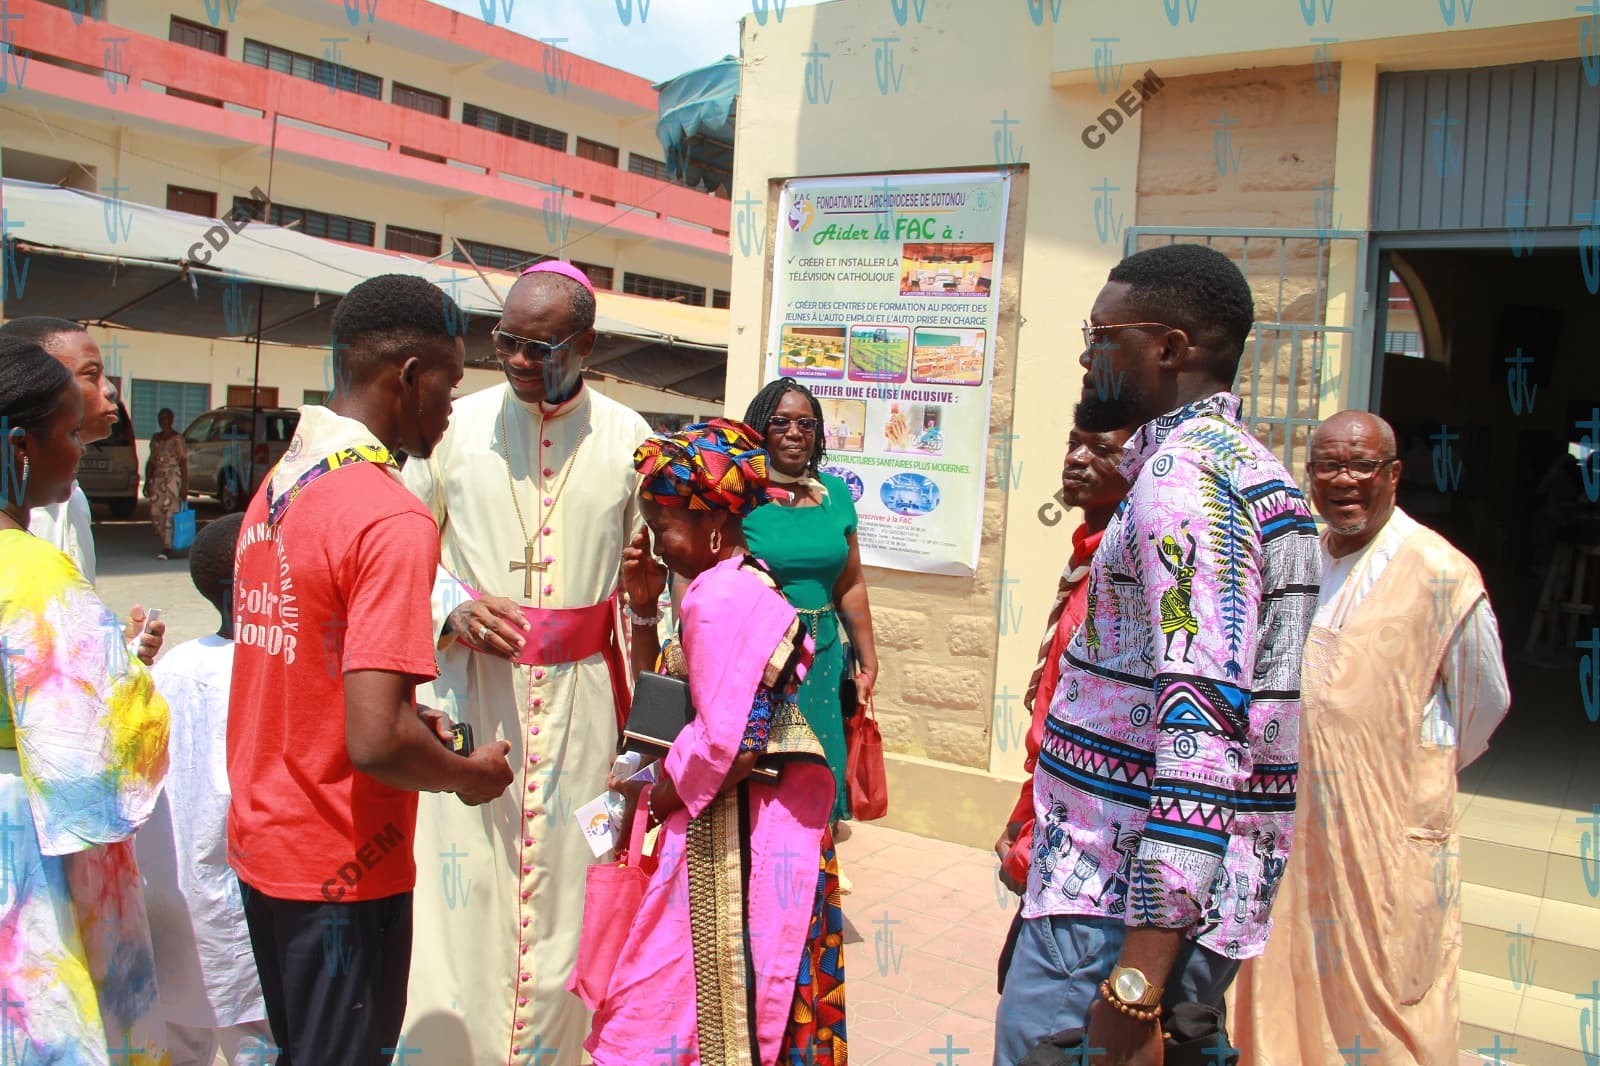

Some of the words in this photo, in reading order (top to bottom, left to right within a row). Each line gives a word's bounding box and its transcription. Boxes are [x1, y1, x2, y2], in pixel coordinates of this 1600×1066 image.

[816, 195, 852, 209] FONDATION
[854, 195, 863, 208] DE
[921, 193, 929, 207] DE
[931, 192, 966, 206] COTONOU
[813, 223, 869, 245] Aider
[874, 223, 890, 240] la
[895, 217, 936, 240] FAC
[942, 225, 953, 239] à
[798, 256, 824, 267] CRÉER
[826, 258, 836, 266] ET
[838, 258, 885, 267] INSTALLER
[887, 258, 899, 267] LA
[789, 271, 835, 281] TÉLÉVISION
[837, 272, 895, 282] CATHOLIQUE
[794, 301, 817, 309] CRÉER
[832, 302, 865, 310] CENTRES
[866, 302, 877, 310] DE
[879, 302, 925, 311] FORMATION
[941, 303, 970, 312] PROFIT
[785, 312, 810, 321] JEUNES
[810, 311, 817, 320] À
[819, 313, 844, 321] L'AUTO
[846, 314, 874, 322] EMPLOI
[887, 315, 915, 323] L'AUTO
[917, 316, 938, 324] PRISE
[952, 316, 987, 325] CHARGE
[846, 386, 863, 398] UNE
[866, 385, 898, 400] ÉGLISE
[900, 389, 953, 402] INCLUSIVE
[876, 457, 912, 469] SANITAIRES
[914, 460, 930, 470] PLUS
[899, 516, 913, 524] FAC
